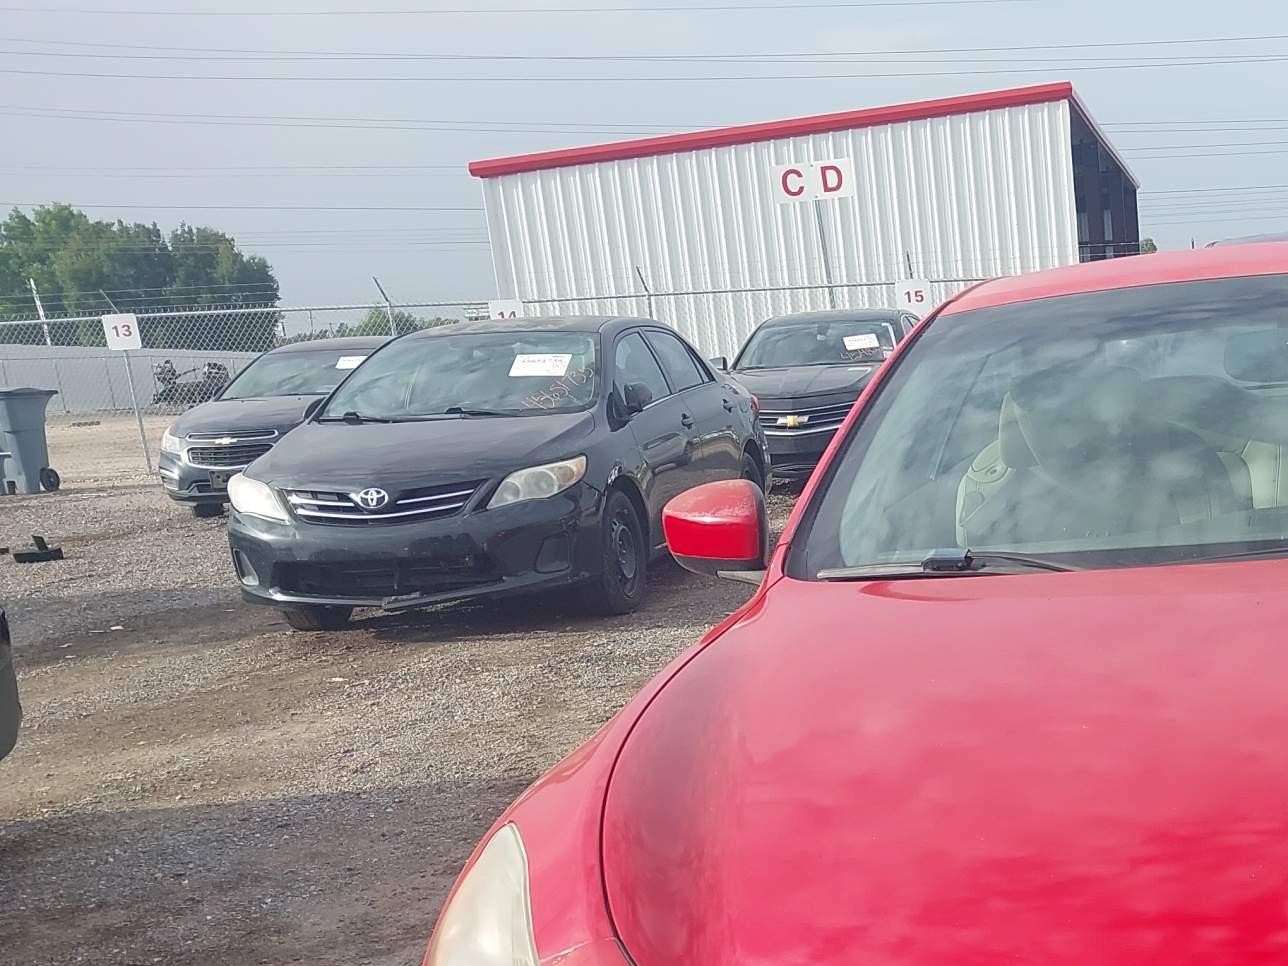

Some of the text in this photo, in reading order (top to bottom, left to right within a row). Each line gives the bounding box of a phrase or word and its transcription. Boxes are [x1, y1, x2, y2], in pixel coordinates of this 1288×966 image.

[781, 165, 843, 197] C D
[903, 289, 924, 304] 15
[111, 323, 132, 338] 13
